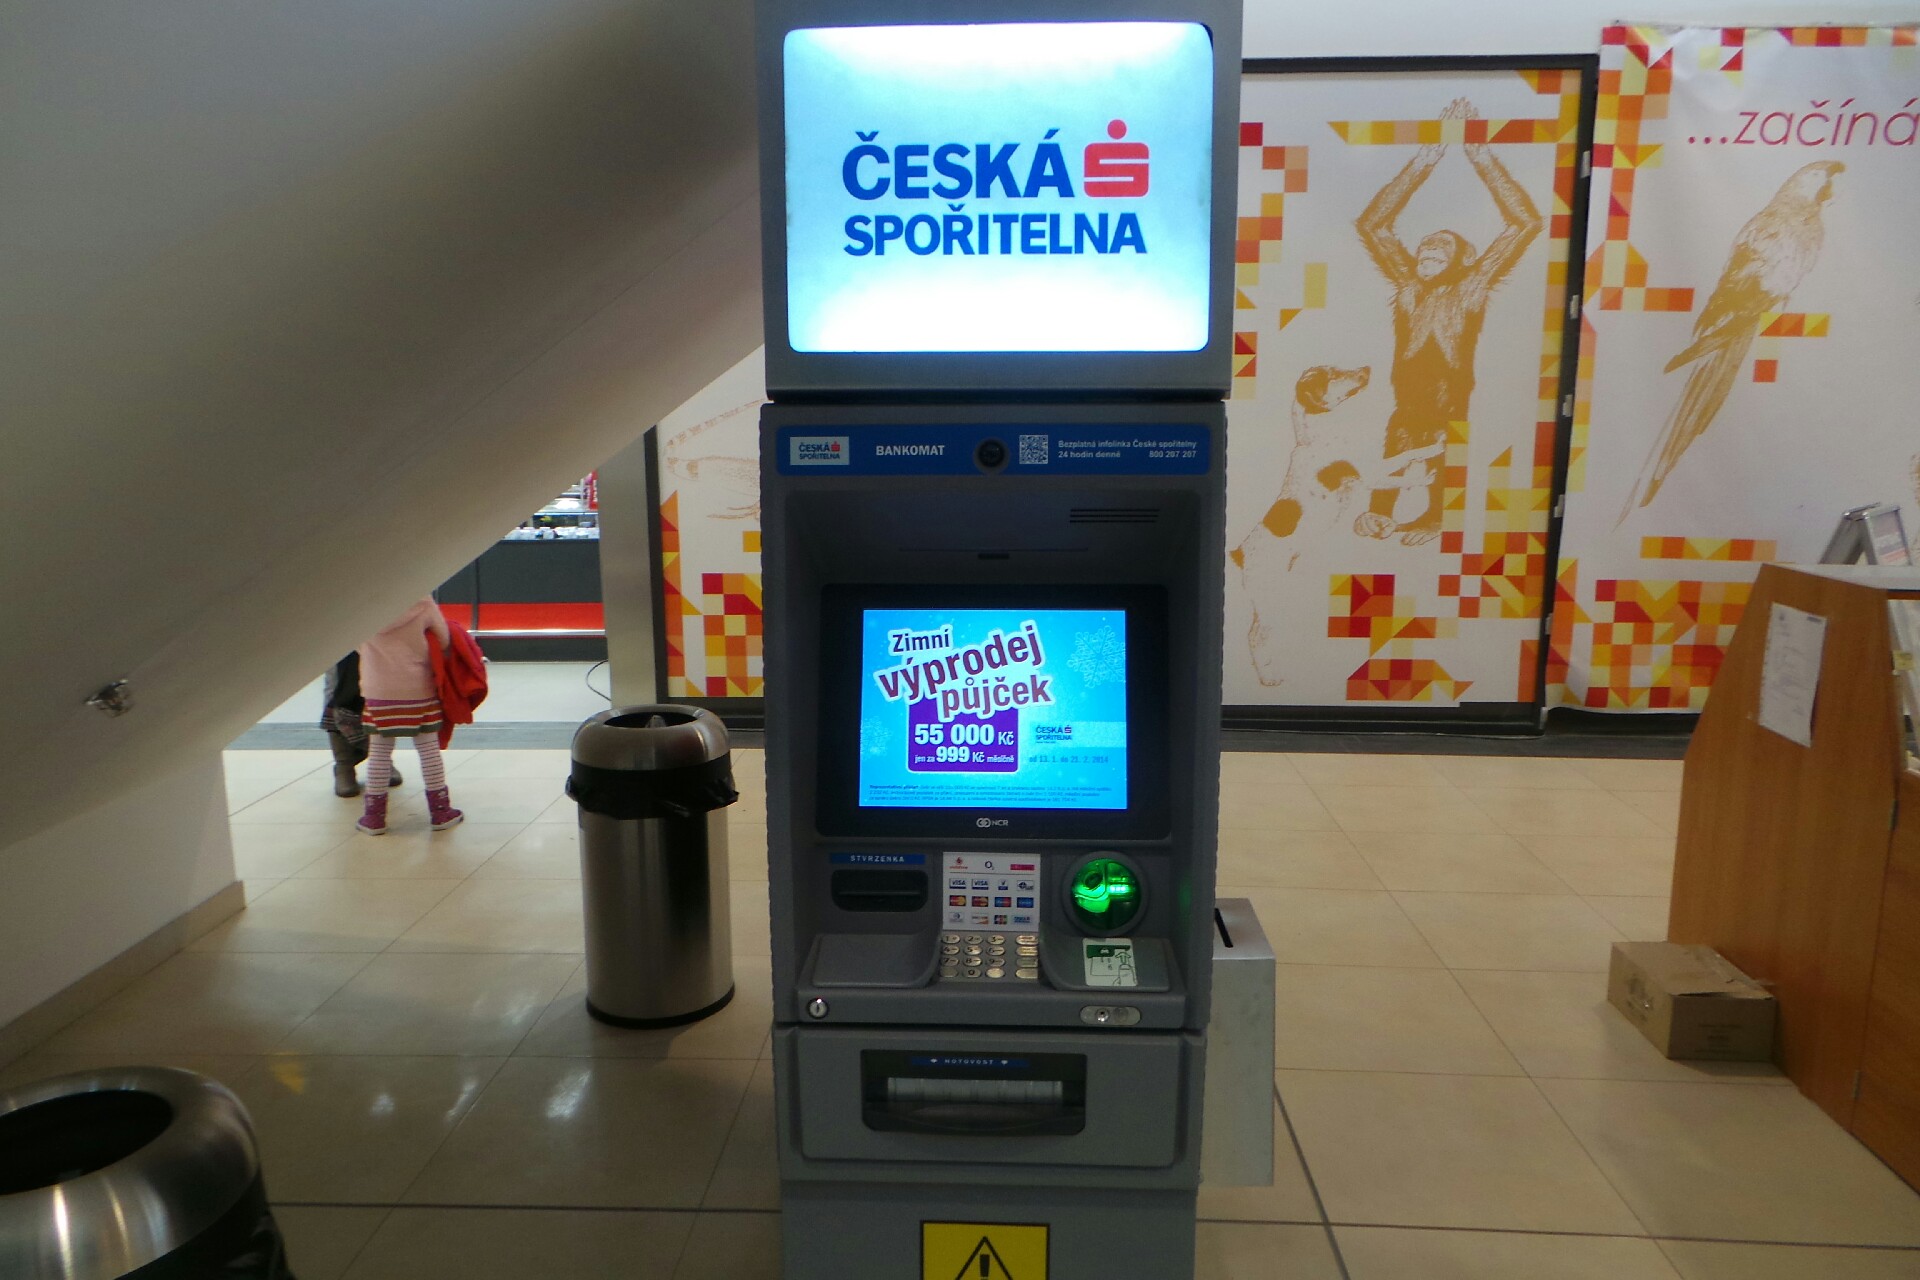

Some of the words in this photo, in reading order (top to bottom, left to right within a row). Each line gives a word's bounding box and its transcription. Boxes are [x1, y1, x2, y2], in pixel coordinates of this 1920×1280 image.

[842, 128, 1075, 200] ČESKÁ
[843, 203, 1147, 256] SPOŘITELNA
[798, 441, 830, 452] ČESKÁ
[1058, 440, 1096, 449] Bezplatná
[1097, 440, 1131, 448] infolinka
[1133, 438, 1157, 448] České
[1158, 439, 1197, 449] spořitelny
[799, 452, 840, 460] SPOŘITELNA
[876, 445, 945, 456] BANKOMAT
[1070, 450, 1094, 458] hodin
[1095, 450, 1121, 458] denně
[1149, 450, 1164, 458] 800
[1165, 450, 1180, 458] 207
[1182, 450, 1197, 458] 207
[892, 629, 950, 653] Zimní
[878, 624, 1043, 701] výprodej
[941, 674, 1052, 718] půjček
[914, 723, 944, 745] 55
[950, 723, 995, 745] 000
[998, 731, 1014, 746] Kč
[1035, 724, 1063, 734] ČESKÁ
[914, 755, 926, 764] jen
[936, 746, 970, 763] 999
[972, 751, 985, 763] Kč
[986, 754, 1014, 763] měsíčně
[1029, 754, 1037, 763] od
[1060, 755, 1068, 763] do
[991, 819, 1009, 827] NCR
[850, 854, 905, 863] STVRZENKA
